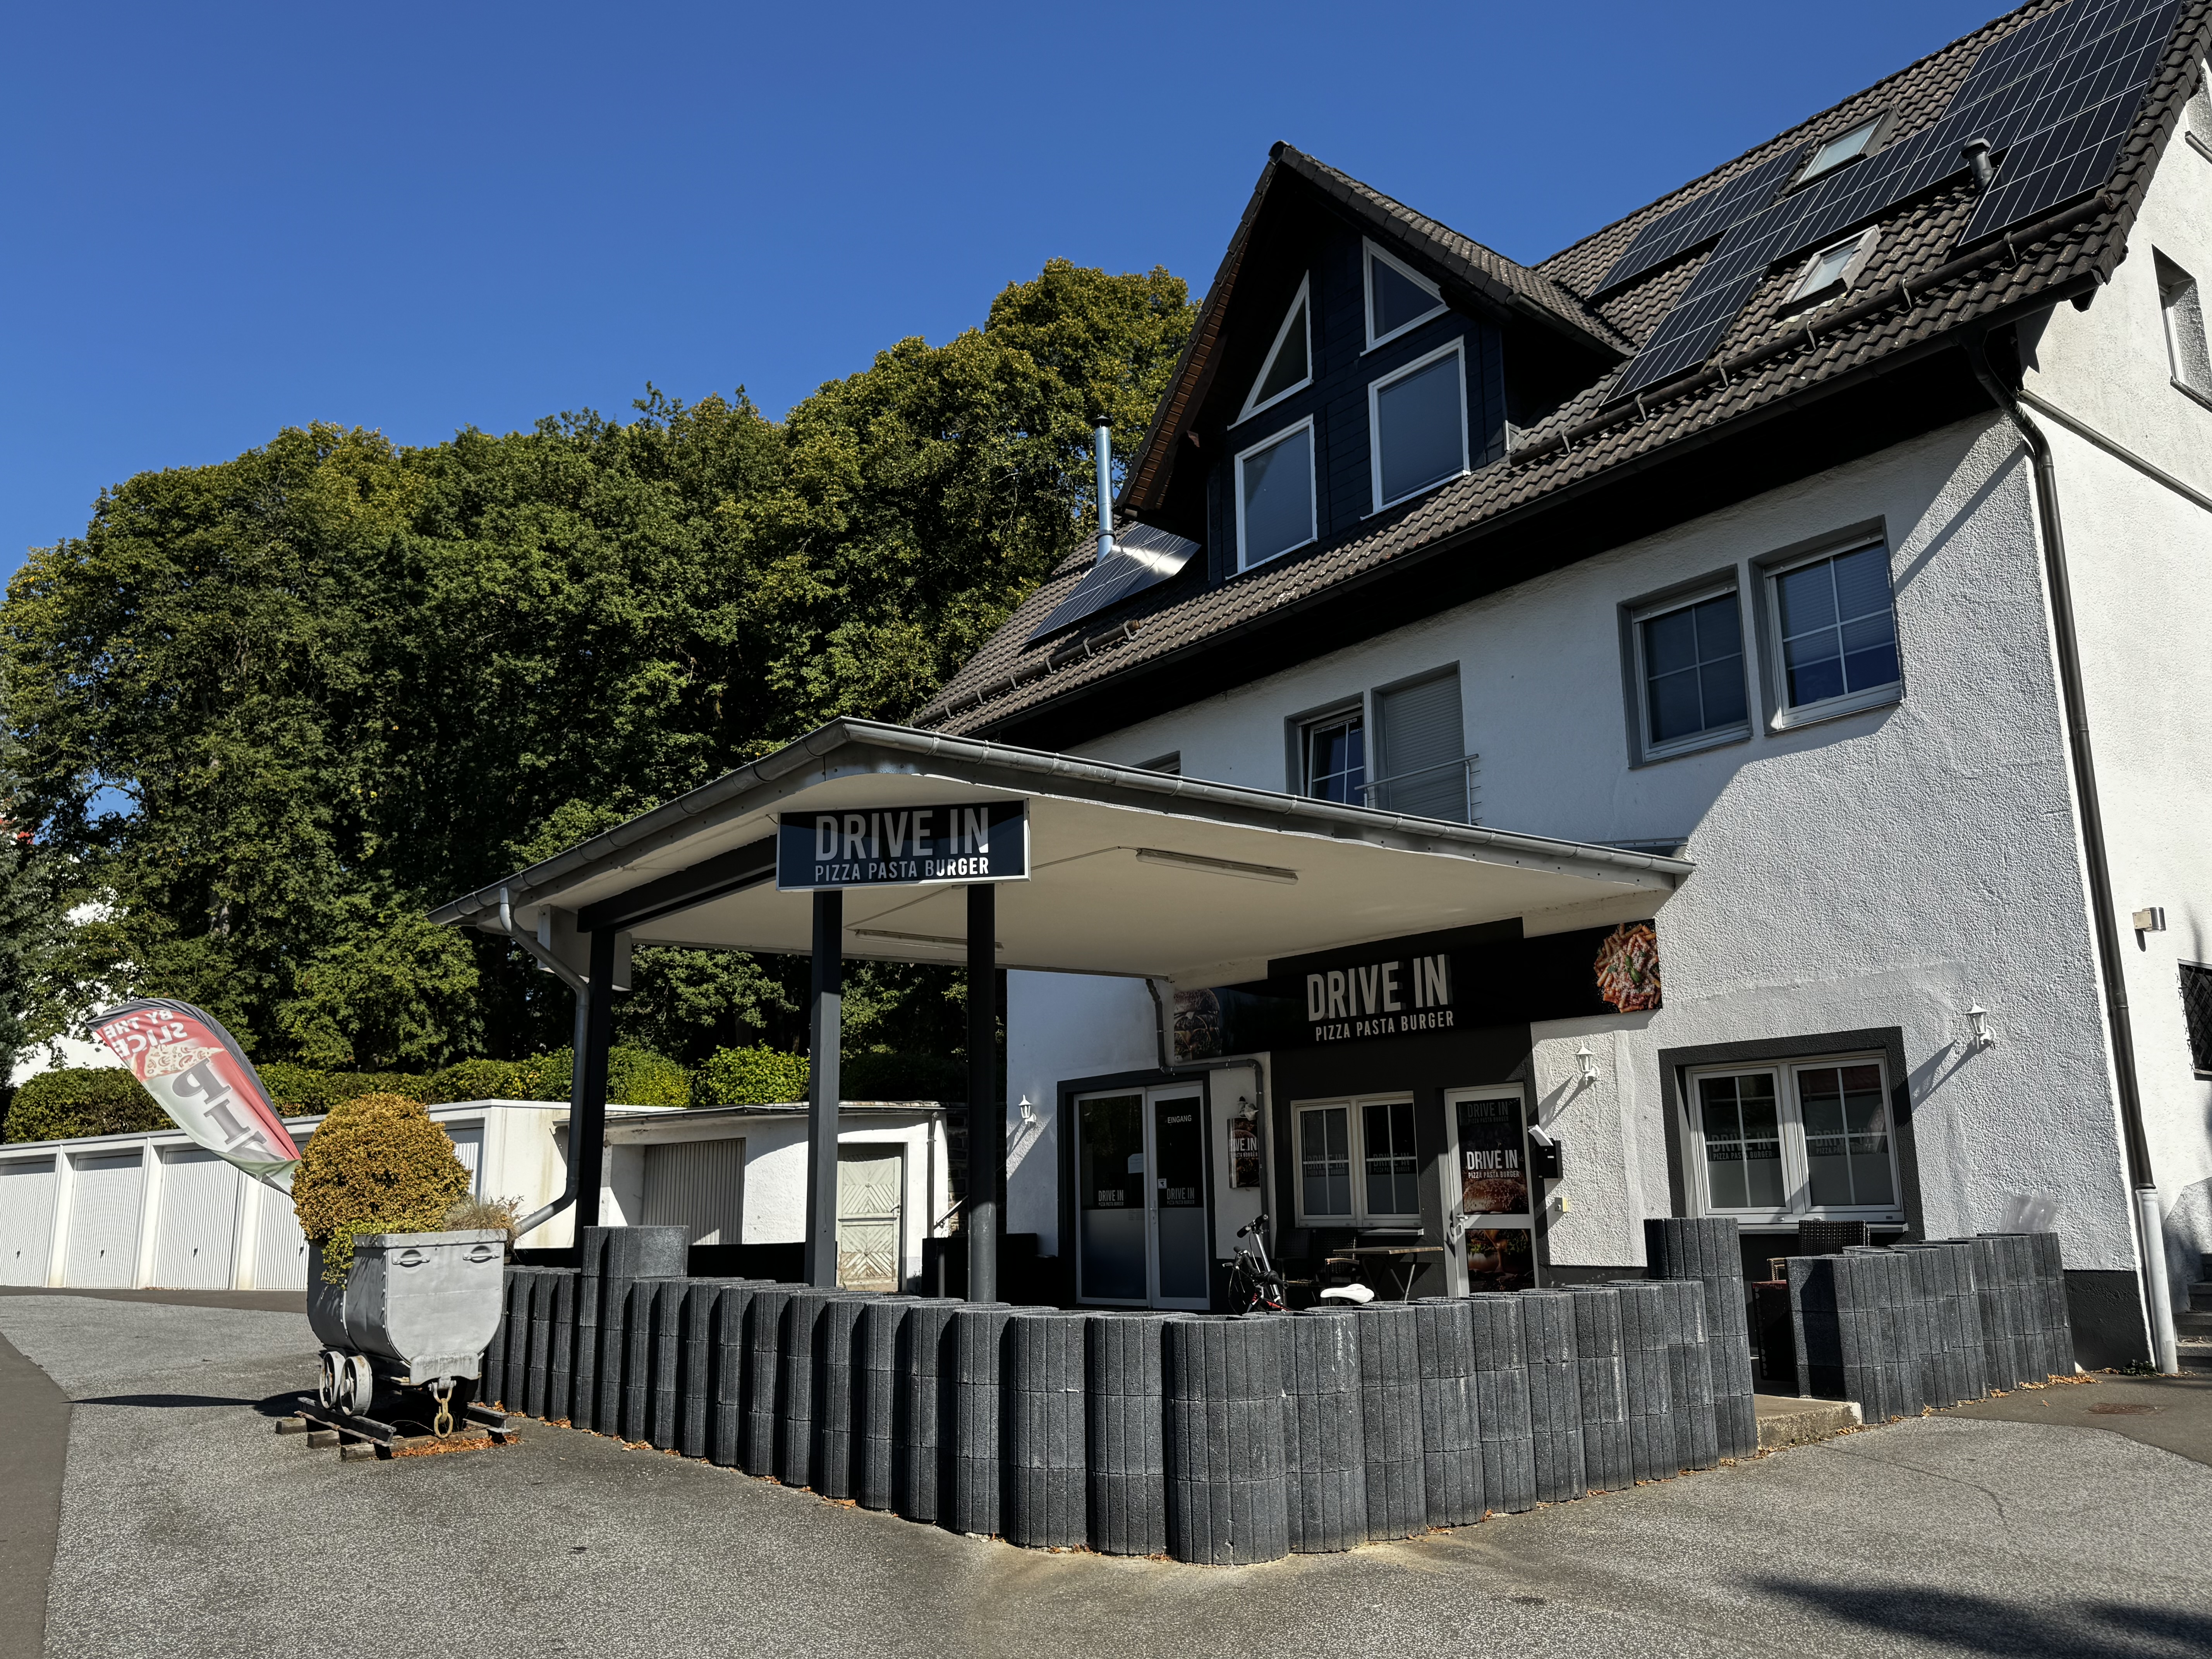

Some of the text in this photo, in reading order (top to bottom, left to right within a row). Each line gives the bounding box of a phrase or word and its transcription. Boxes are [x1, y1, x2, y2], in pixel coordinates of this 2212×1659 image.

[815, 807, 989, 862] DRIVE IN
[815, 857, 989, 882] PIZZA PASTA BURGER
[1307, 954, 1451, 1022] DRIVE IN
[1316, 1010, 1454, 1041] PIZZA PASTA BURGER
[1467, 1101, 1509, 1118] DRIVE IN
[1167, 1115, 1192, 1123] EINGANG
[1247, 1137, 1257, 1151] IN
[1756, 1131, 1772, 1150] IN
[1400, 1152, 1410, 1166] IN
[1466, 1149, 1518, 1170] DRIVE IN
[1098, 1189, 1124, 1202] DRIVE IN
[1167, 1187, 1195, 1200] DRIVE IN
